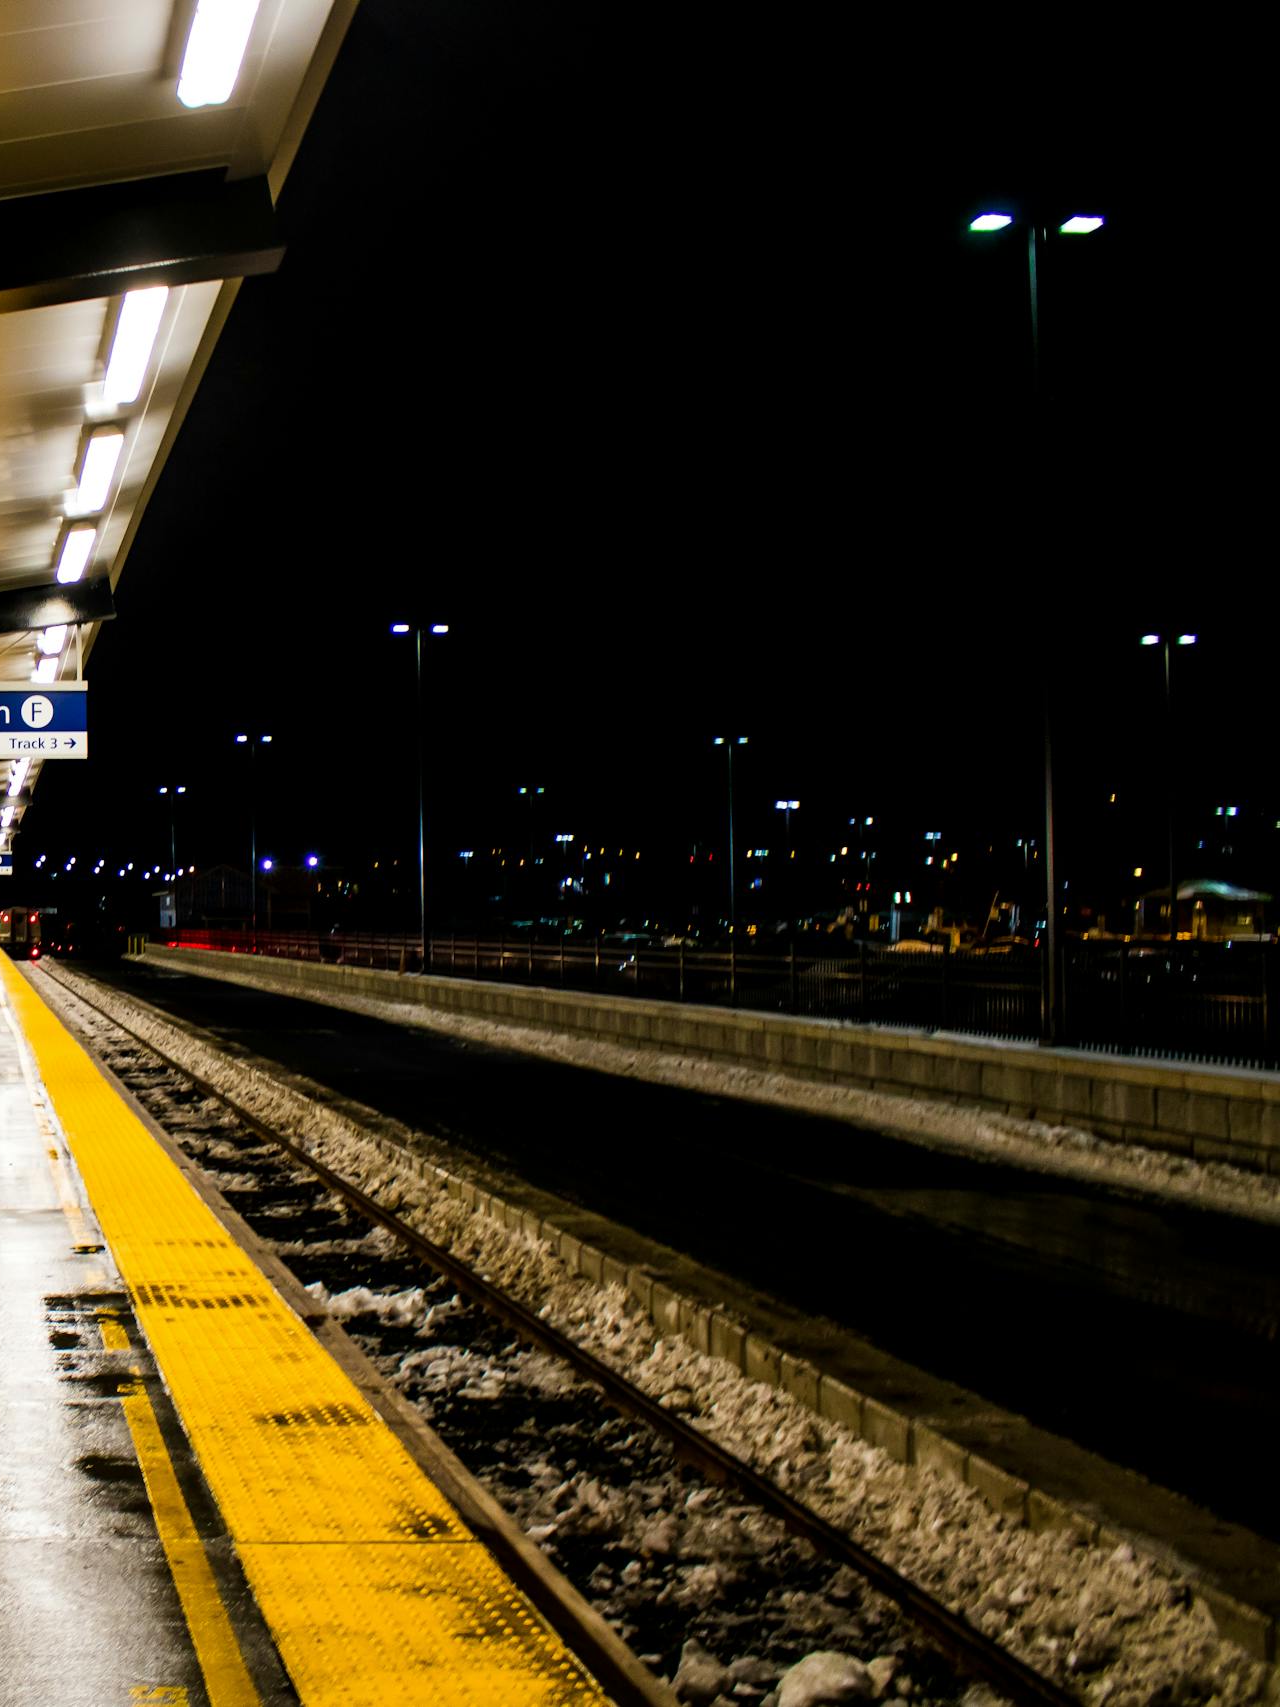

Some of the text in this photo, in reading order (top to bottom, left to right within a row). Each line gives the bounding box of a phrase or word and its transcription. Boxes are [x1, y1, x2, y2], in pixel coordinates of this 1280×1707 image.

[31, 701, 43, 723] F
[9, 737, 58, 750] Track 3
